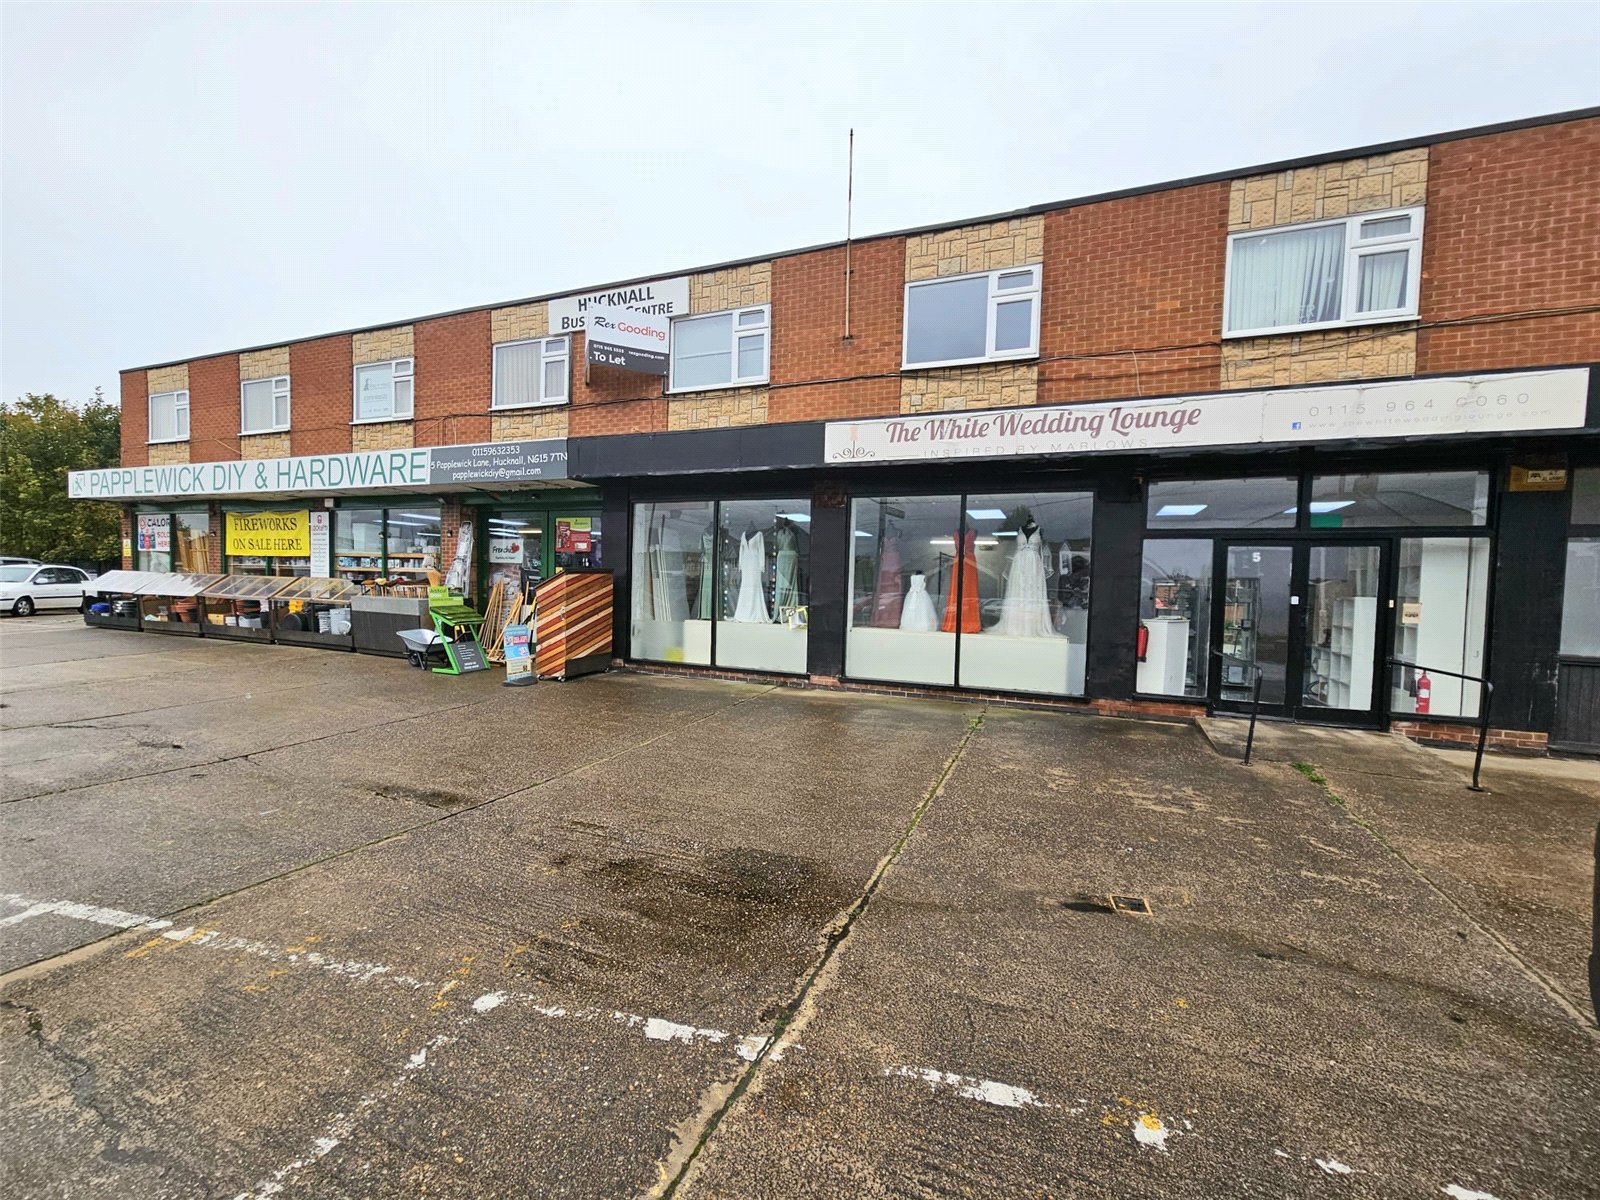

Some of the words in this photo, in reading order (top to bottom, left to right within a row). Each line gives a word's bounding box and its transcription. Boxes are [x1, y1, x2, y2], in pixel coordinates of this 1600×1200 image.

[593, 316, 616, 330] Rex
[617, 322, 666, 341] Gooding
[593, 351, 607, 362] To
[609, 354, 626, 366] Let
[1309, 403, 1366, 417] 0115
[1386, 399, 1434, 412] 964
[886, 421, 921, 444] The
[924, 418, 990, 441] White
[993, 411, 1105, 439] Wedding
[1109, 407, 1202, 437] Lounge
[471, 445, 520, 457] 01159632353
[430, 462, 436, 470] 5
[436, 458, 472, 471] Papplewick
[473, 458, 492, 468] Lane,
[493, 456, 526, 467] Hucknall,
[527, 454, 549, 464] NG15
[549, 452, 568, 462] 7TN
[90, 465, 205, 495] PAPPLEWICK
[213, 463, 247, 491] DIY
[254, 461, 269, 489] &
[277, 451, 427, 489] HARDWARE
[452, 467, 542, 481] papplewickdiy@gmail.com
[233, 517, 298, 531] FIREWORKS
[233, 538, 246, 550] ON
[248, 538, 272, 551] SALE
[273, 538, 303, 551] HERE
[1252, 552, 1261, 563] 5
